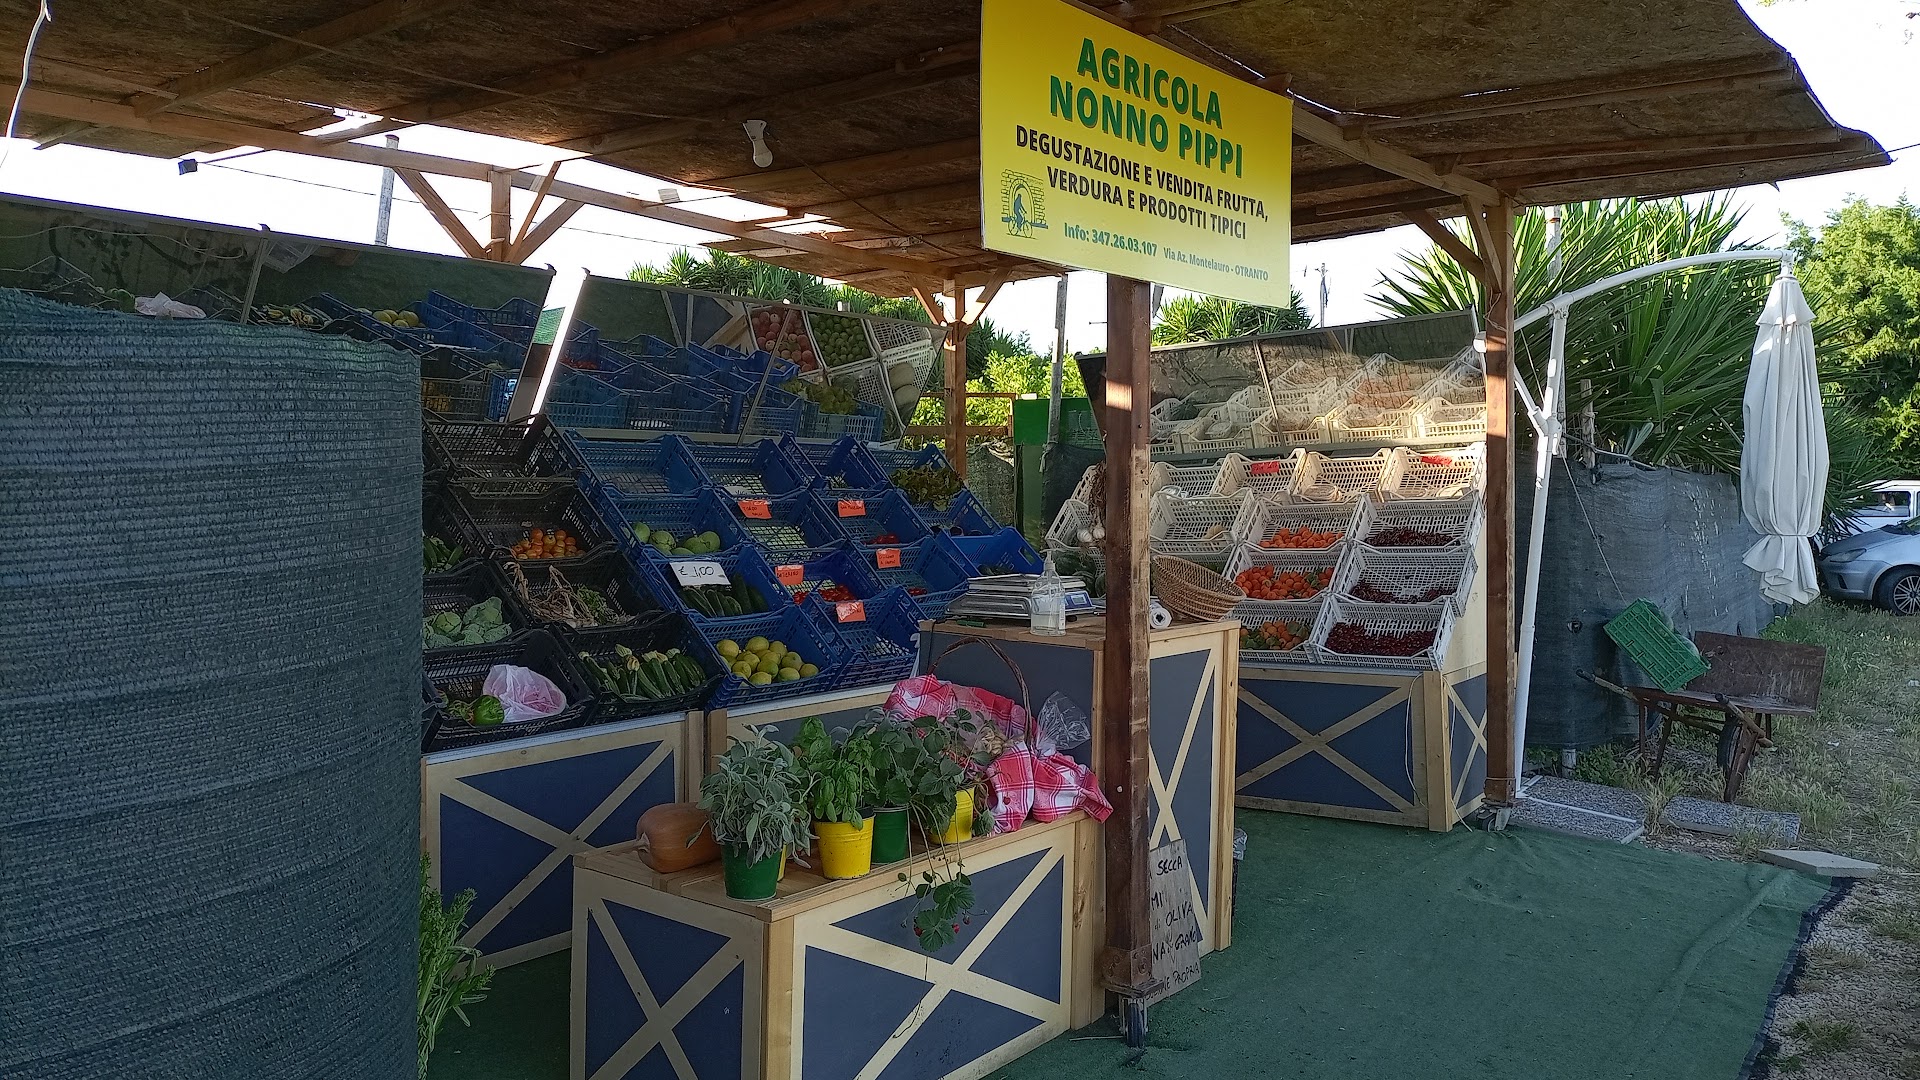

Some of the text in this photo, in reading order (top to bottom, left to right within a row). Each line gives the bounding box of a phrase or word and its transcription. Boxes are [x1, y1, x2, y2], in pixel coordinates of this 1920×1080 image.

[1077, 37, 1222, 129] AGRICOLA
[1050, 75, 1243, 178] NONNO PIPPI
[1016, 124, 1269, 223] DEGUSTAZIONE E VENDITA FRUTTA,
[1046, 165, 1247, 240] VERDURA E PRODOTTI TIPICI
[1064, 222, 1158, 257] Info: 347.26.03.107
[1163, 246, 1176, 261] Via
[1177, 250, 1188, 264] Az.
[1189, 253, 1230, 273] Montelauro
[1234, 264, 1269, 281] OTRANTO
[1156, 855, 1183, 876] SECCA
[1165, 900, 1194, 927] OLIVA
